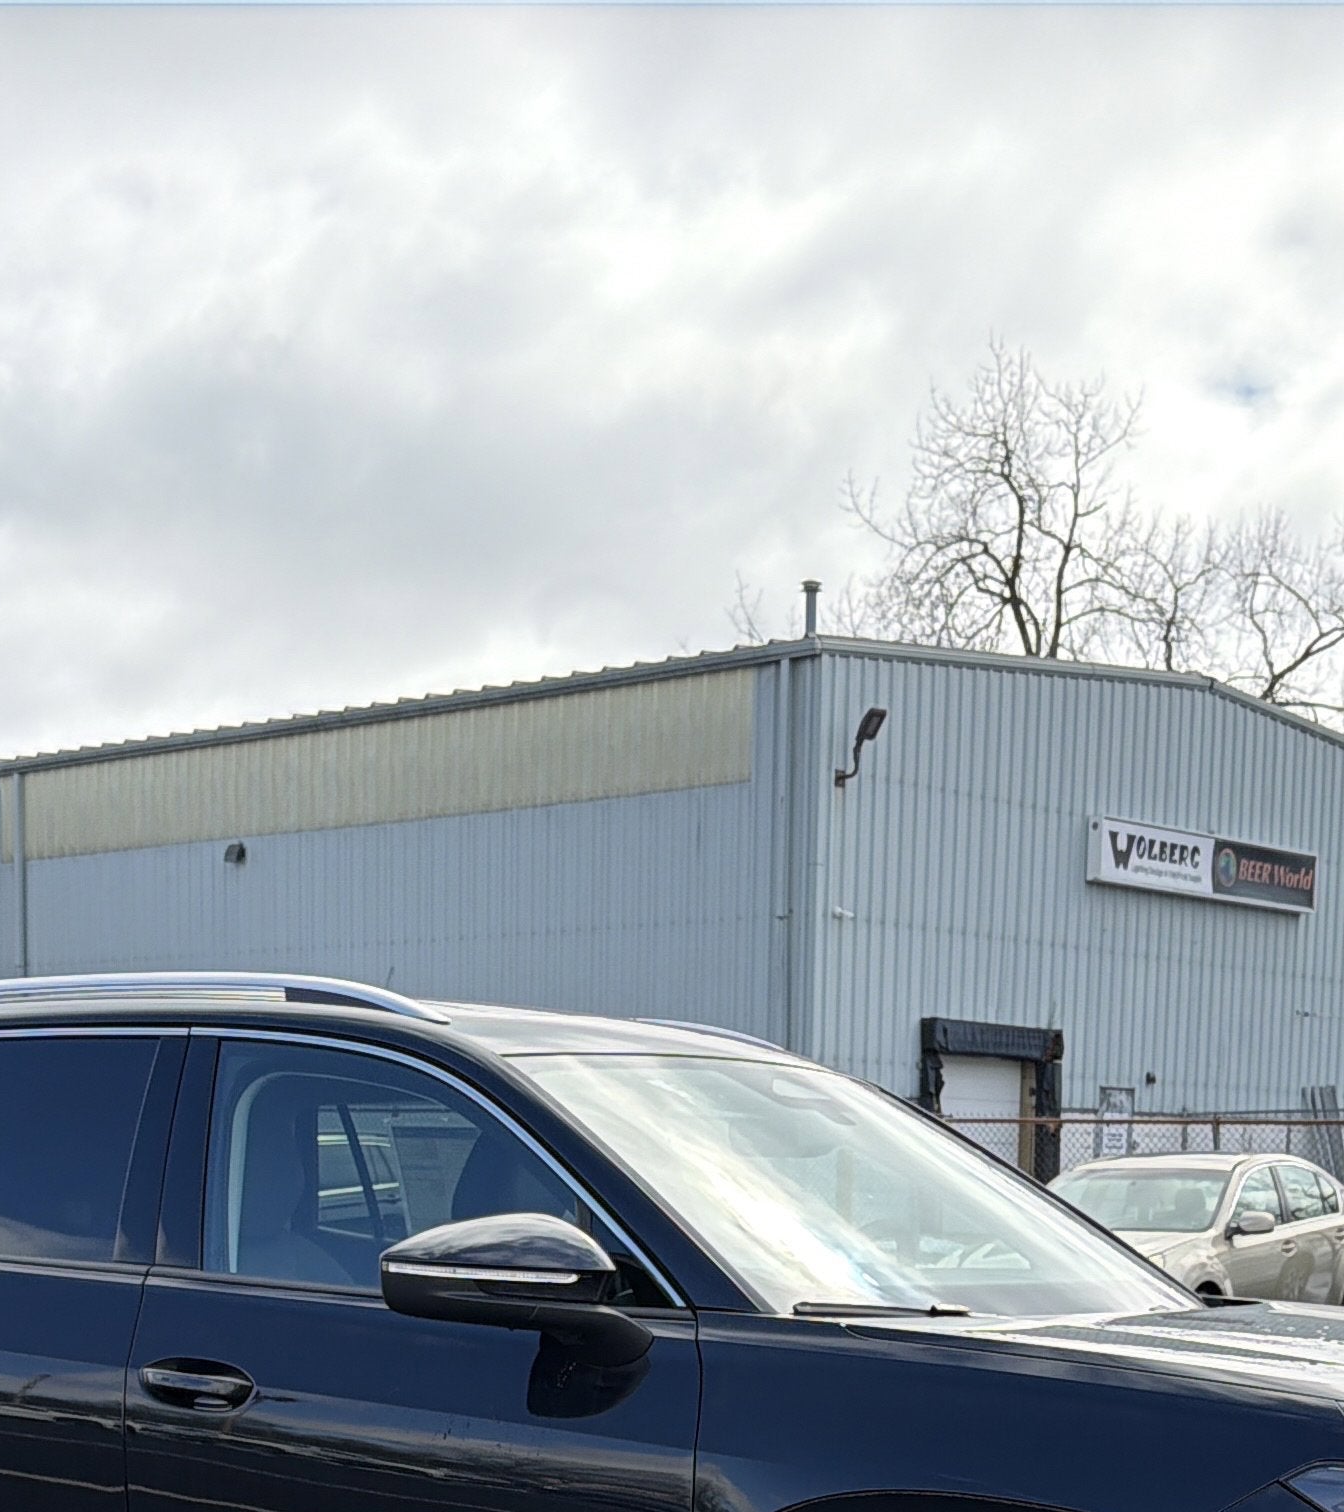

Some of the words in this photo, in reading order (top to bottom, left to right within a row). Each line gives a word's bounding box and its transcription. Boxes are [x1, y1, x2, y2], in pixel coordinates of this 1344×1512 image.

[1108, 830, 1201, 871] WOLBERG
[1238, 857, 1271, 884] BEER
[1273, 865, 1313, 891] World
